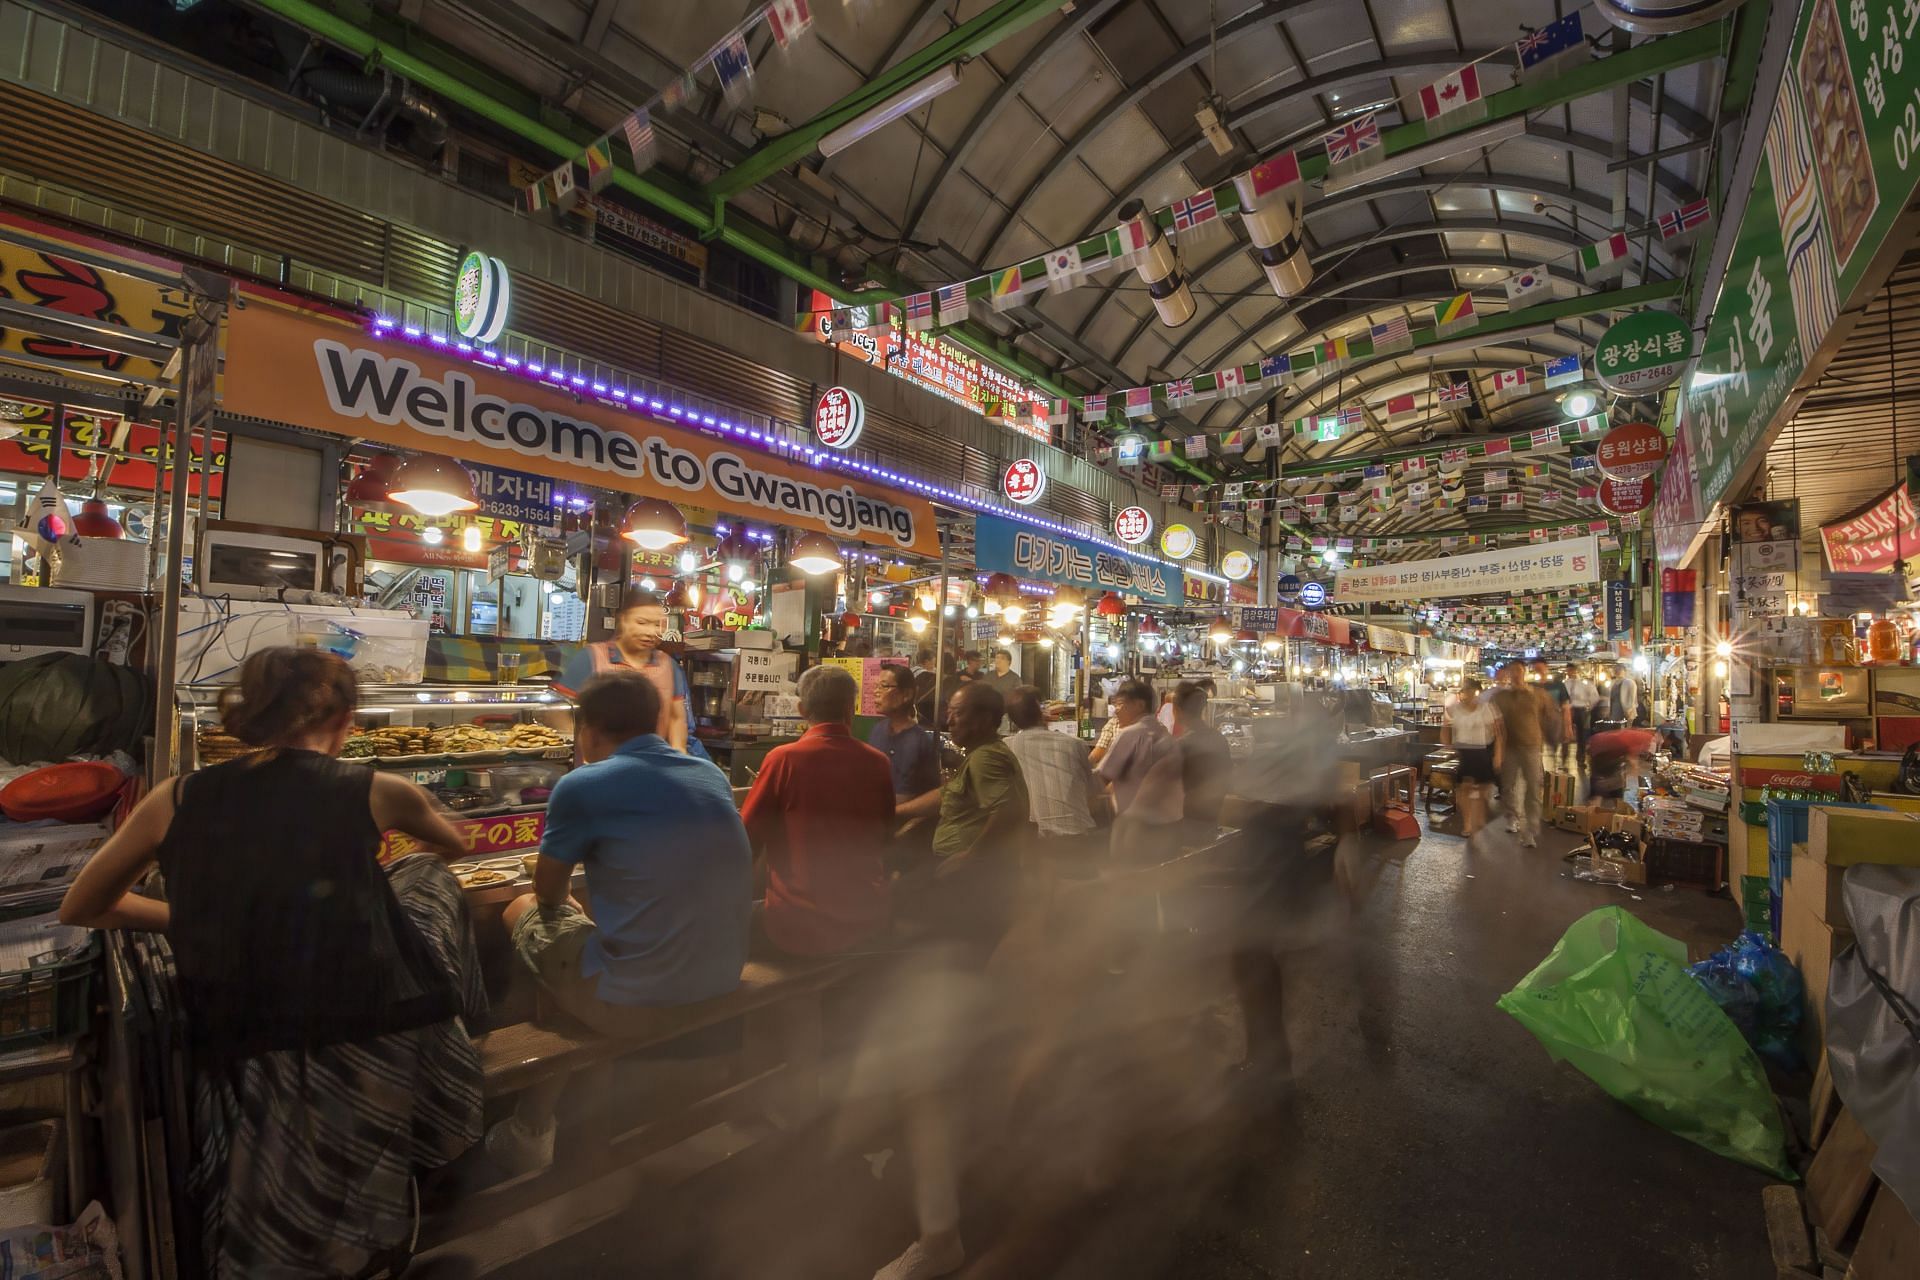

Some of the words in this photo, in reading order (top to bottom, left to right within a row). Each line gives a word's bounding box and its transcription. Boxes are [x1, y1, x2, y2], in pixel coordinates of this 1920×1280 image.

[1894, 88, 1920, 170] 02
[1602, 330, 1685, 367] 광장식품
[1618, 365, 1672, 385] 2267-2648
[325, 346, 638, 471] Welcome
[649, 442, 701, 485] to
[711, 457, 913, 542] Gwangjang
[1601, 436, 1662, 459] 동원상회
[480, 499, 551, 522] 0-6233-1564
[1016, 532, 1092, 581] 다가가는
[464, 816, 540, 849] 子の家
